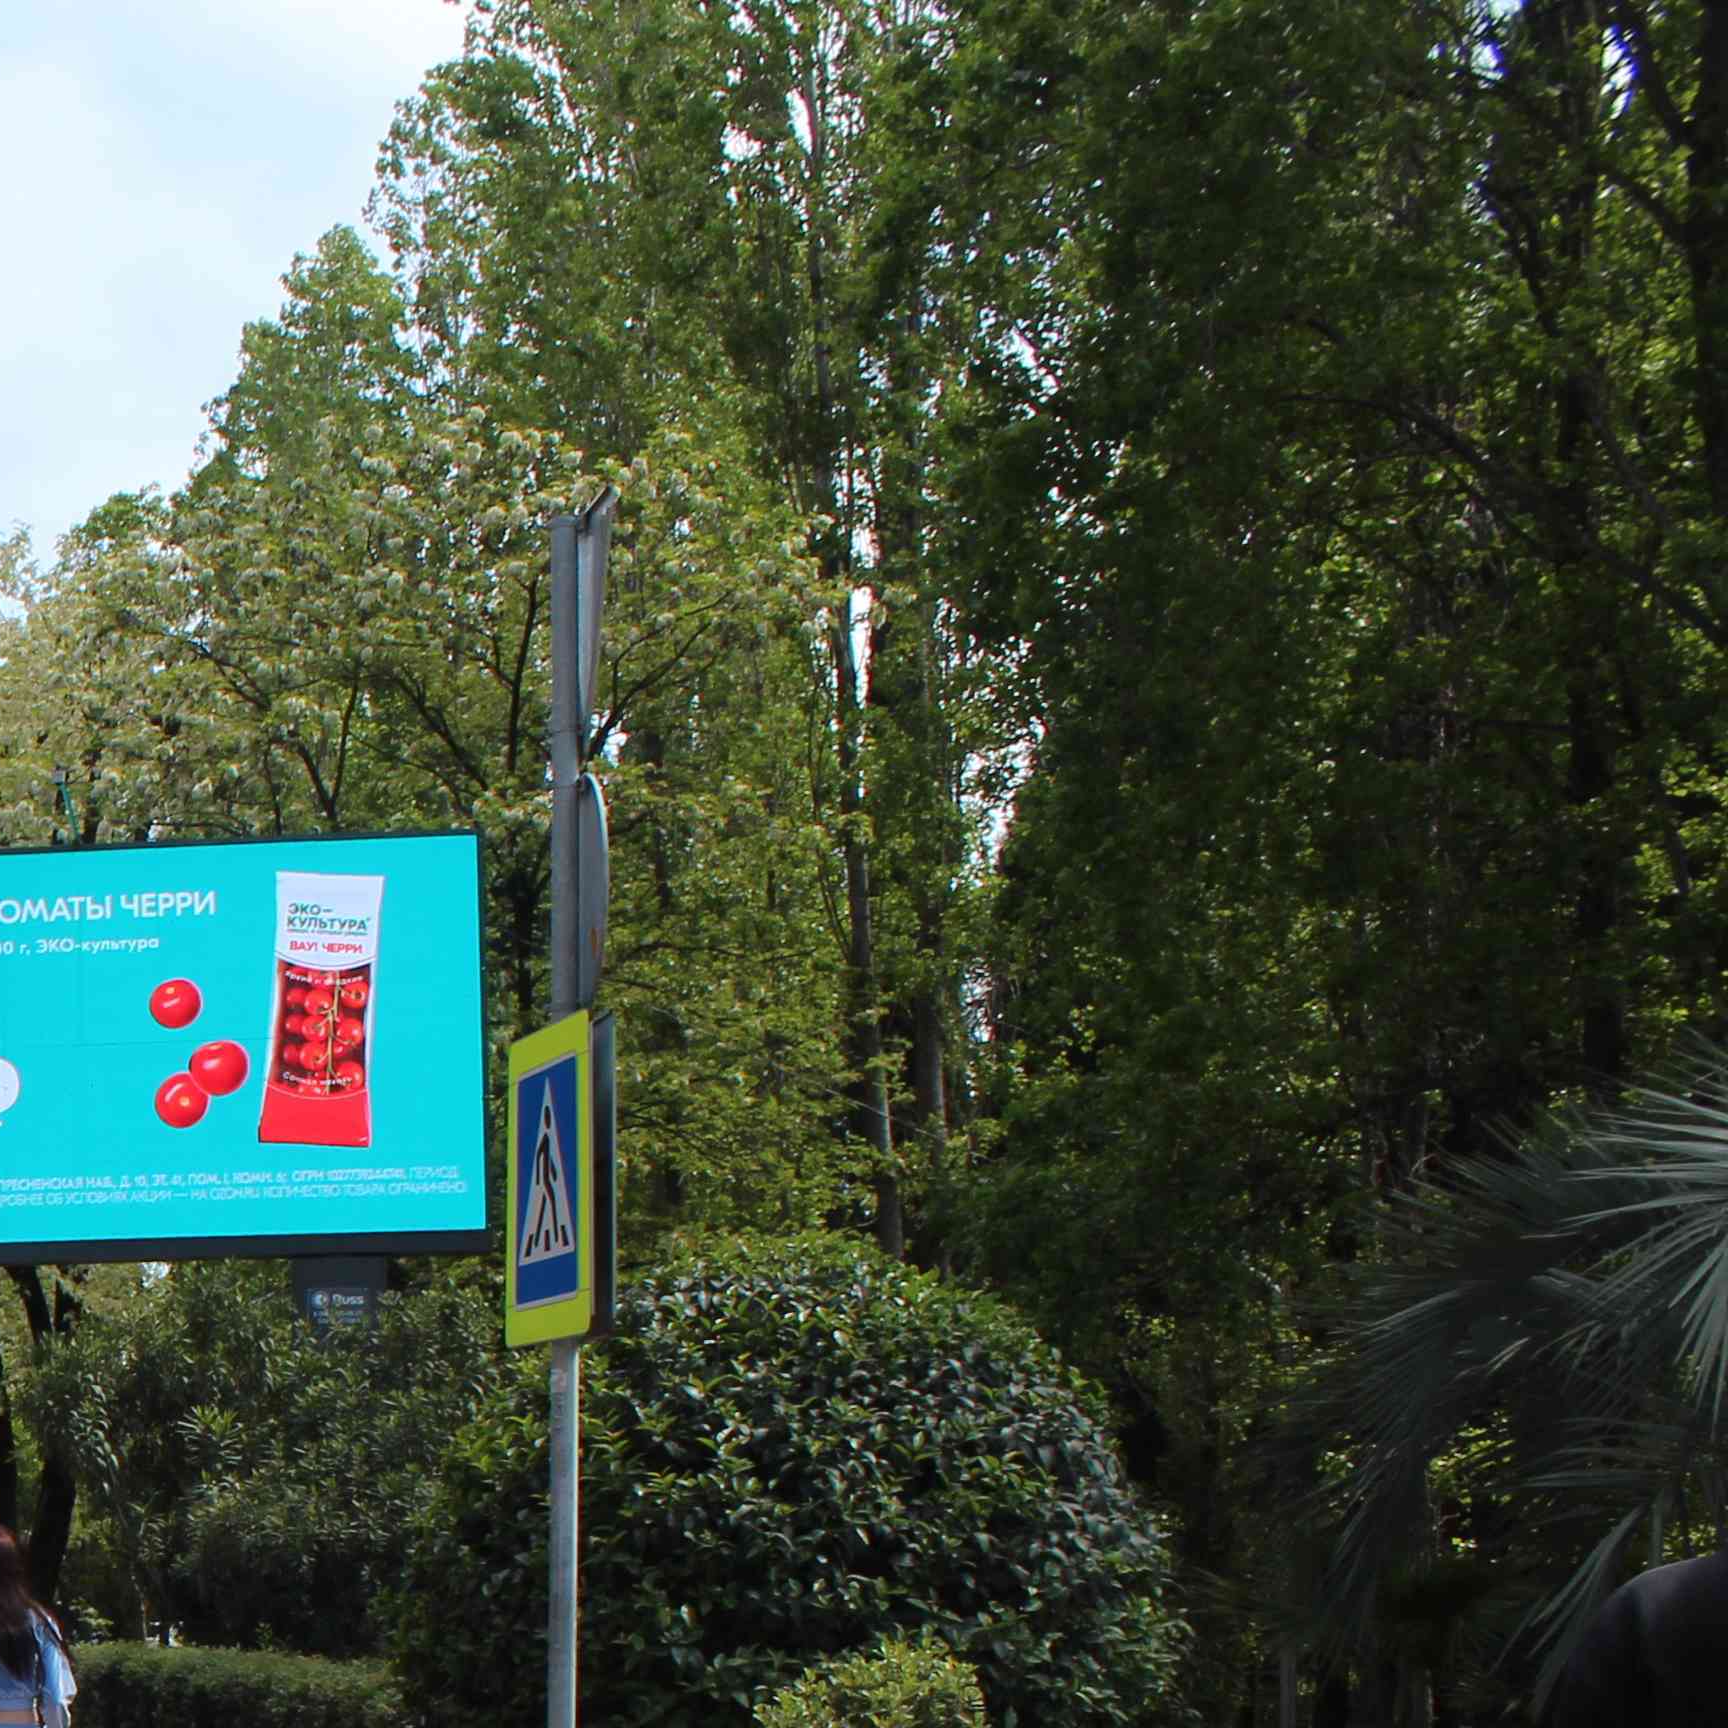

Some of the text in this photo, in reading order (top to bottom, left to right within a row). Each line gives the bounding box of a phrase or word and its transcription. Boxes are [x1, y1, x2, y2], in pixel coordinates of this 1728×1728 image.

[120, 890, 216, 919] ЧЕРРИ
[35, 936, 160, 955] ЭКО-культура
[321, 942, 363, 953] ЧЕРРИ
